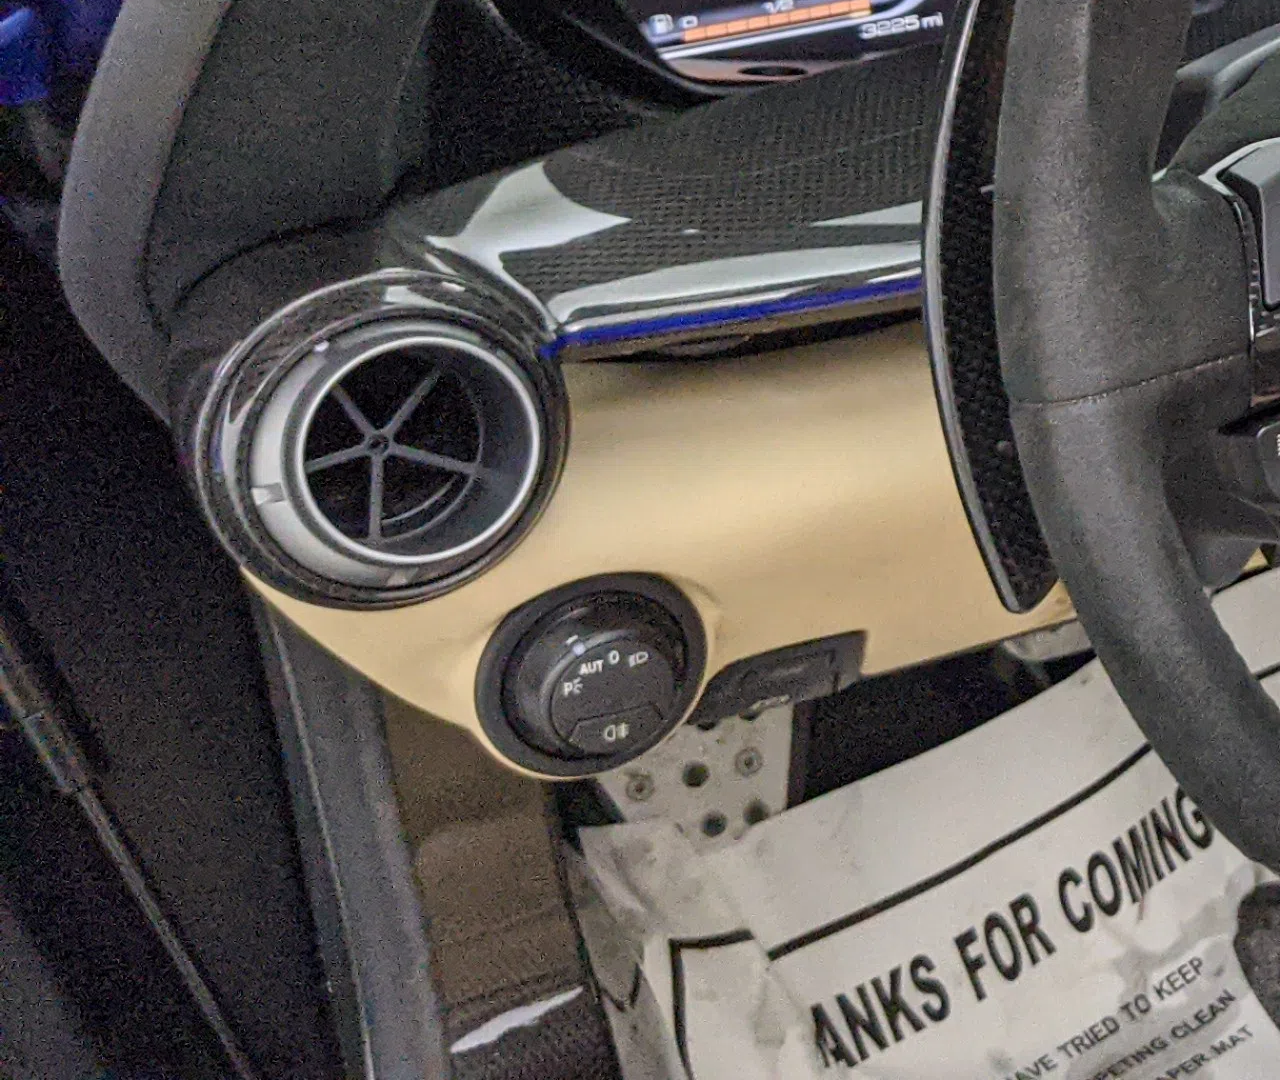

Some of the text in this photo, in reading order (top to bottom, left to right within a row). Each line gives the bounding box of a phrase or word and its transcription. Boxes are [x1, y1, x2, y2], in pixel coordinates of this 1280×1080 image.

[859, 14, 920, 39] 3225
[811, 783, 1214, 1067] ANKS FOR COMING
[1005, 956, 1204, 1080] AVE TRIED TO KEEP
[1170, 989, 1237, 1040] CLEAN
[1210, 1024, 1254, 1056] MAT
